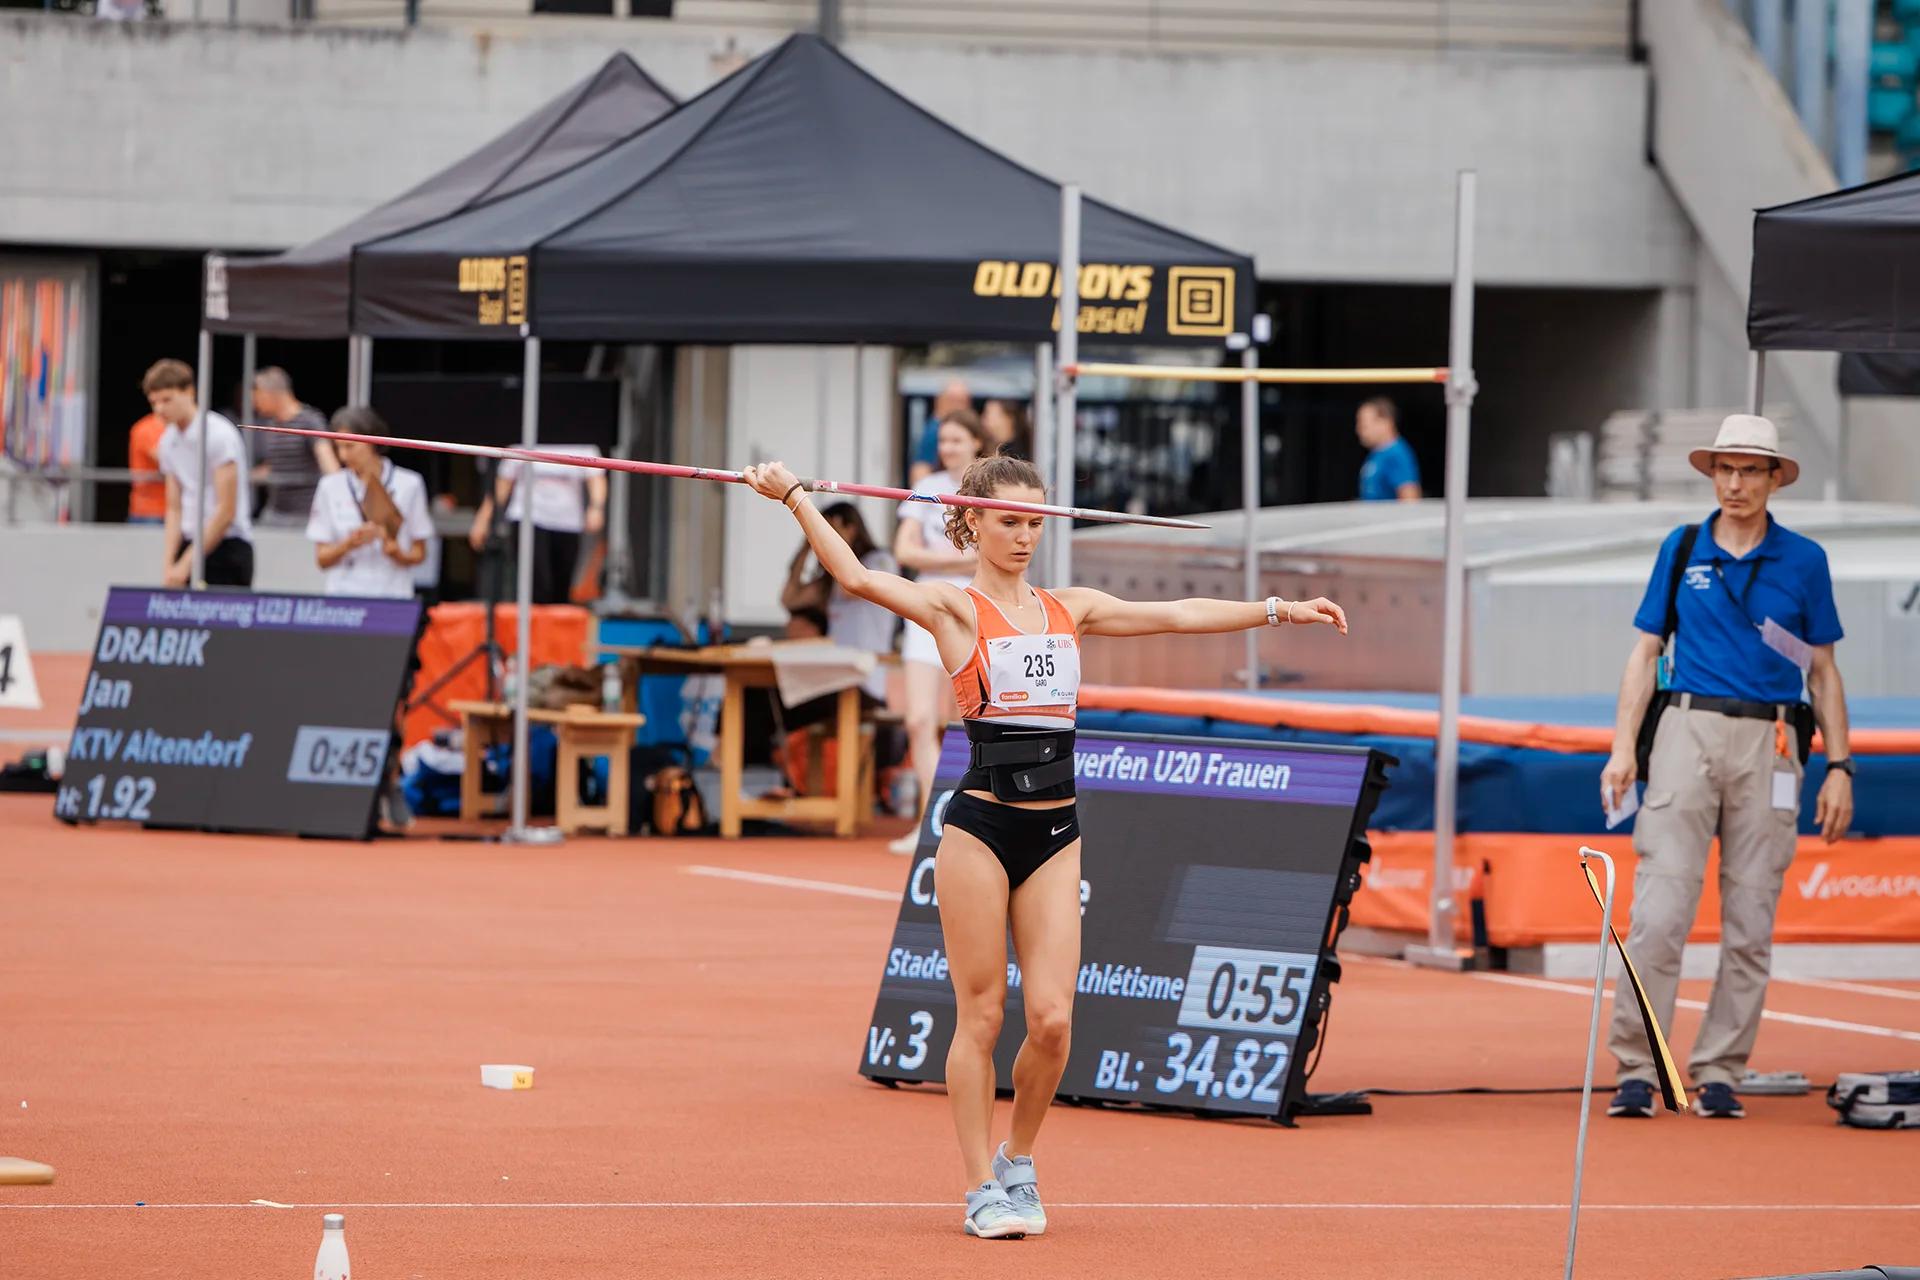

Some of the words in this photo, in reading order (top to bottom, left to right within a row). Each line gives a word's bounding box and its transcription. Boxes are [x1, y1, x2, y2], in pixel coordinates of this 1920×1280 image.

[973, 260, 1050, 297] OLD
[146, 593, 256, 628] Hochsprung
[98, 625, 210, 667] DRABIK
[1024, 654, 1055, 678] 235
[80, 671, 133, 716] Jan
[71, 728, 123, 761] KTV
[122, 730, 253, 769] Altendorf
[308, 737, 382, 779] 0:45
[1152, 749, 1201, 784] U20
[1202, 753, 1291, 790] Frauen
[86, 774, 157, 818] 1.92
[886, 947, 949, 980] Stade
[1077, 963, 1185, 1001] thlétisme
[1206, 961, 1306, 1026] 0:55
[867, 1025, 897, 1067] V:
[897, 1009, 935, 1072] 3
[1095, 1049, 1145, 1092] BL:
[1155, 1031, 1290, 1104] 34.82
